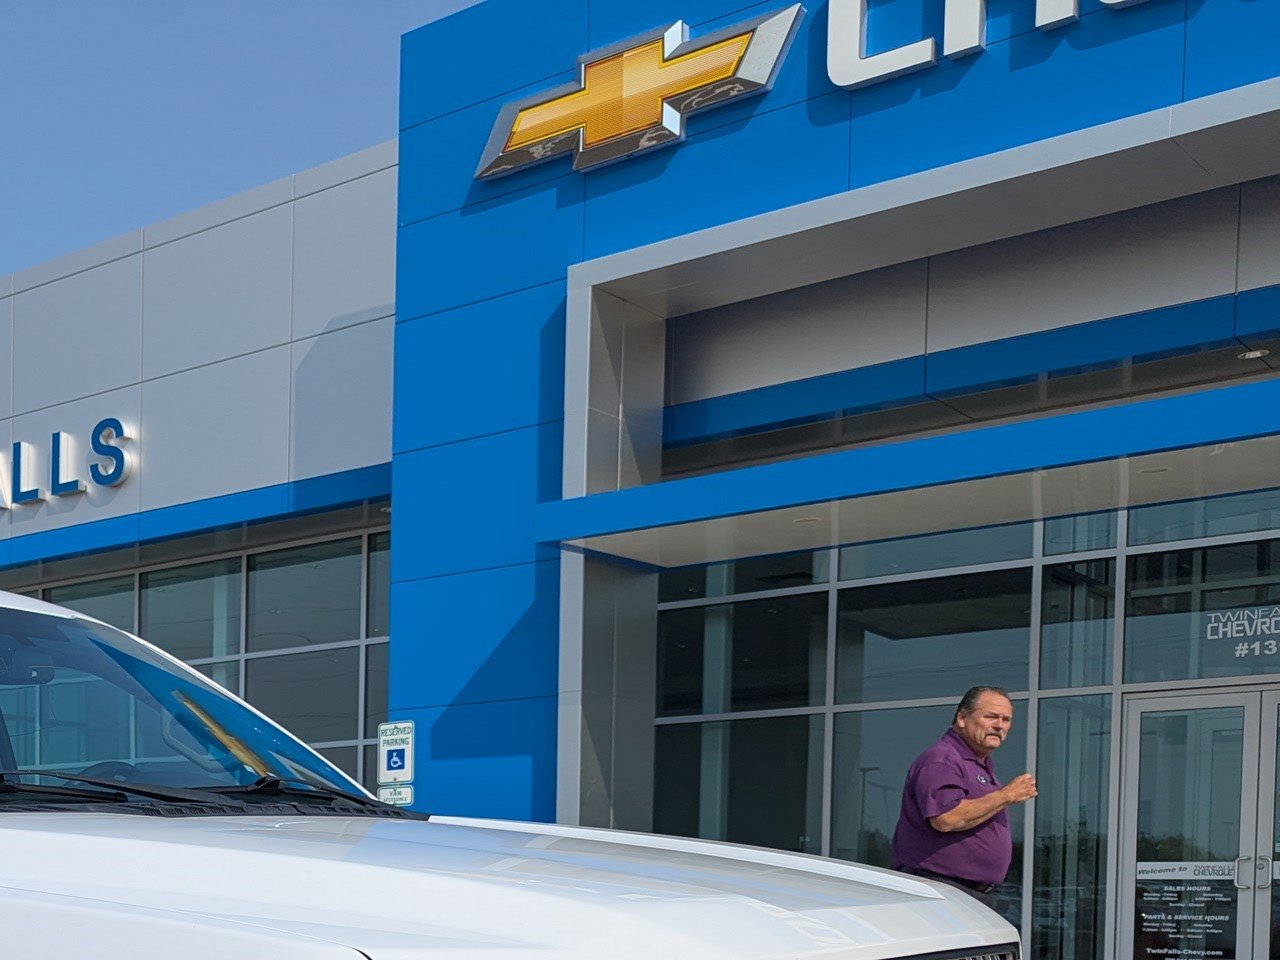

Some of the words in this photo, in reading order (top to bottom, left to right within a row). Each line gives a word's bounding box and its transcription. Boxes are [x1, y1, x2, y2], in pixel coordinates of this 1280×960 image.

[1234, 640, 1280, 657] #13
[380, 726, 412, 737] RESERVED
[382, 737, 410, 747] PARKING
[1138, 867, 1176, 875] Welcome
